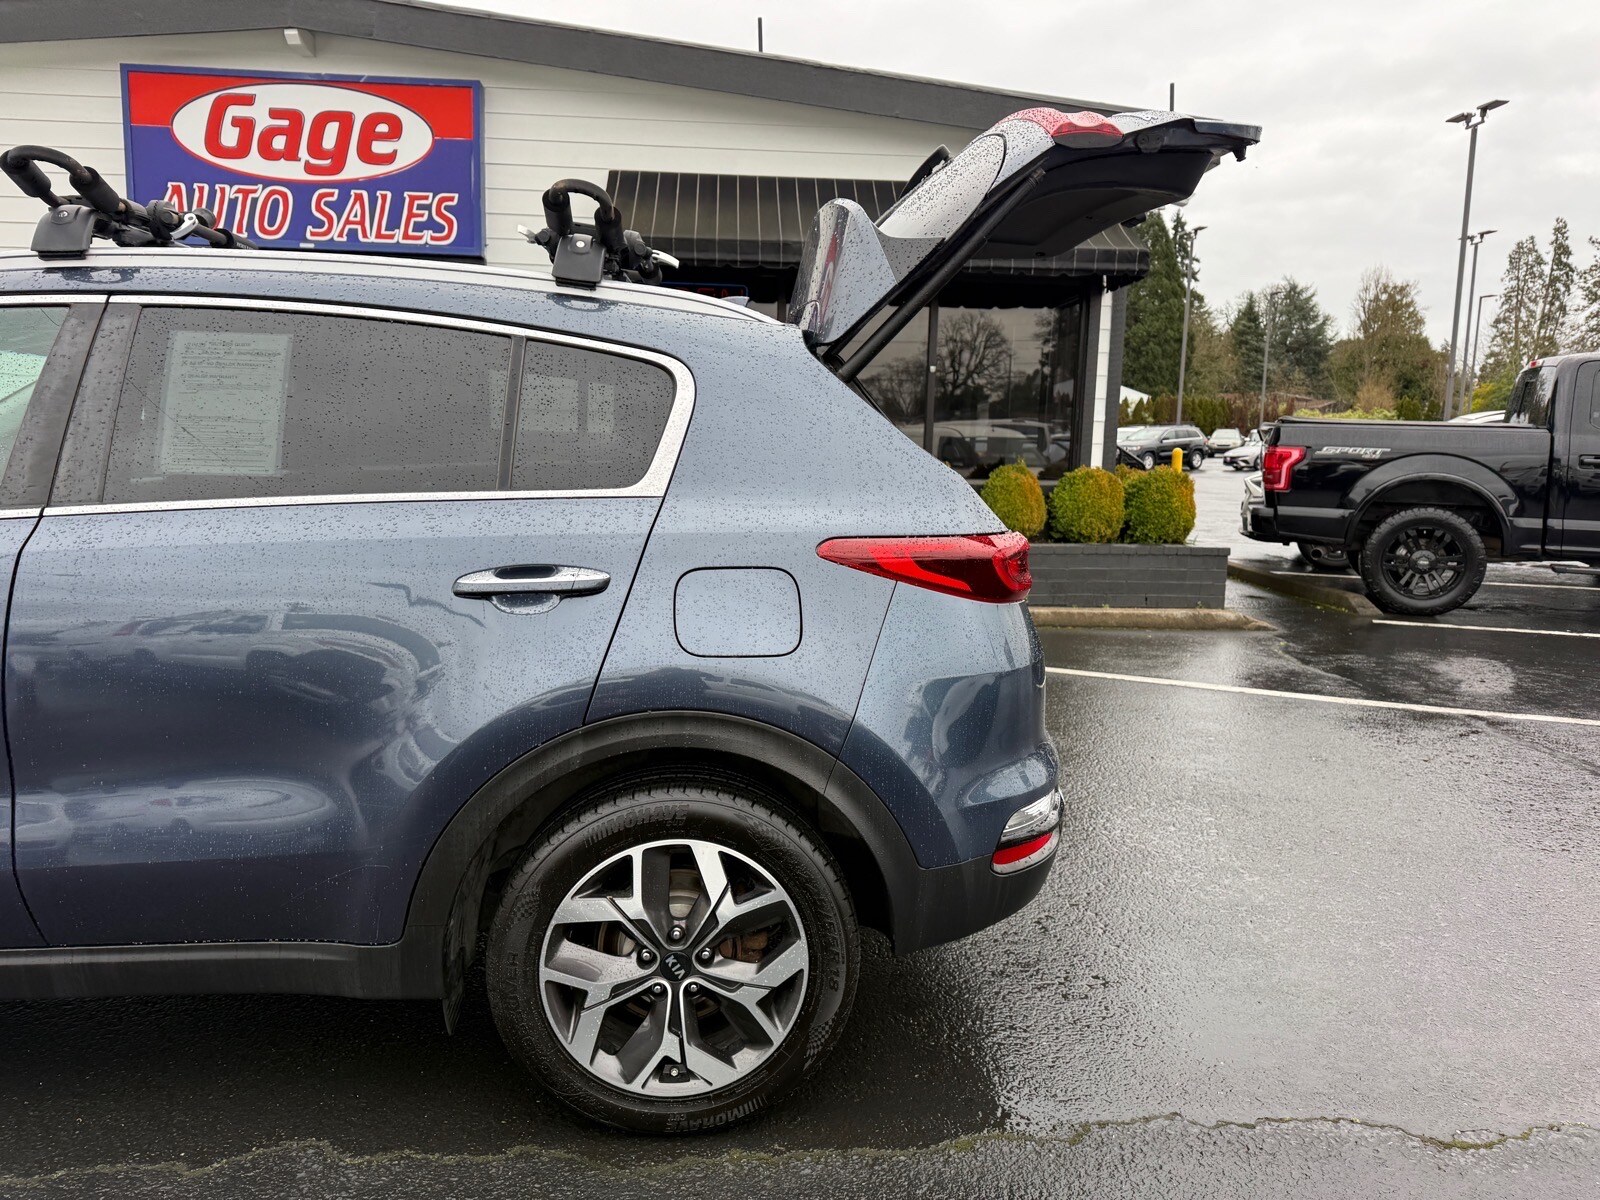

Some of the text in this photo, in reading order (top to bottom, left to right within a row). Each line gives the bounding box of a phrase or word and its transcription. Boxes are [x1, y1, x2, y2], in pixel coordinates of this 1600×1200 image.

[204, 93, 404, 176] Gage
[164, 181, 459, 245] AUTO SALES
[1315, 446, 1391, 456] SPORT
[665, 954, 686, 980] KIA
